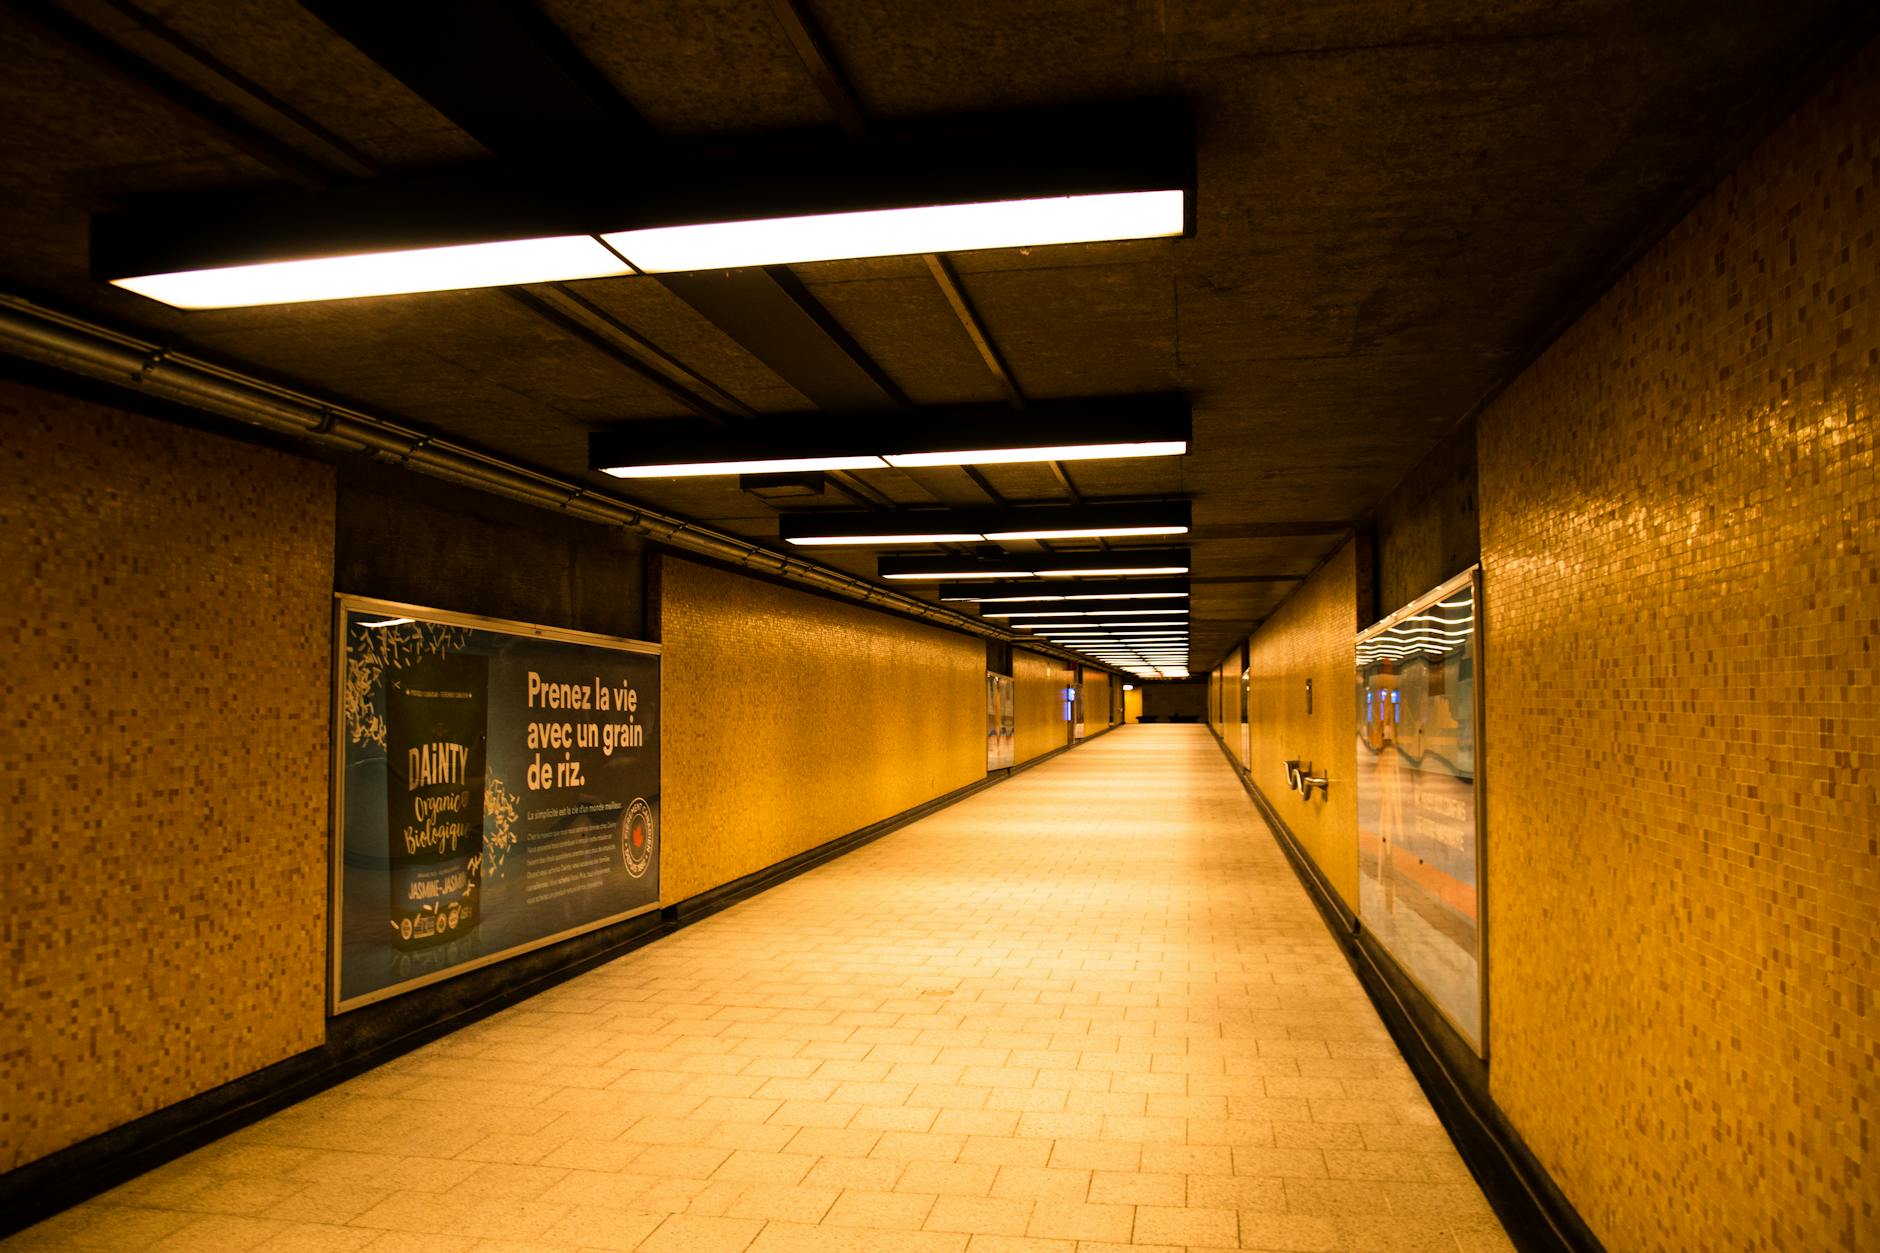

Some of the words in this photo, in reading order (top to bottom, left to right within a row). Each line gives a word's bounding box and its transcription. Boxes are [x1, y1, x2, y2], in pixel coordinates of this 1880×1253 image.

[527, 671, 591, 711] Prenez
[595, 676, 610, 712] la
[613, 679, 637, 713] vie
[527, 721, 572, 750] avec
[577, 722, 599, 749] un
[602, 715, 643, 757] grain
[527, 752, 553, 791] de
[557, 751, 585, 788] riz.
[414, 792, 461, 826] Organic
